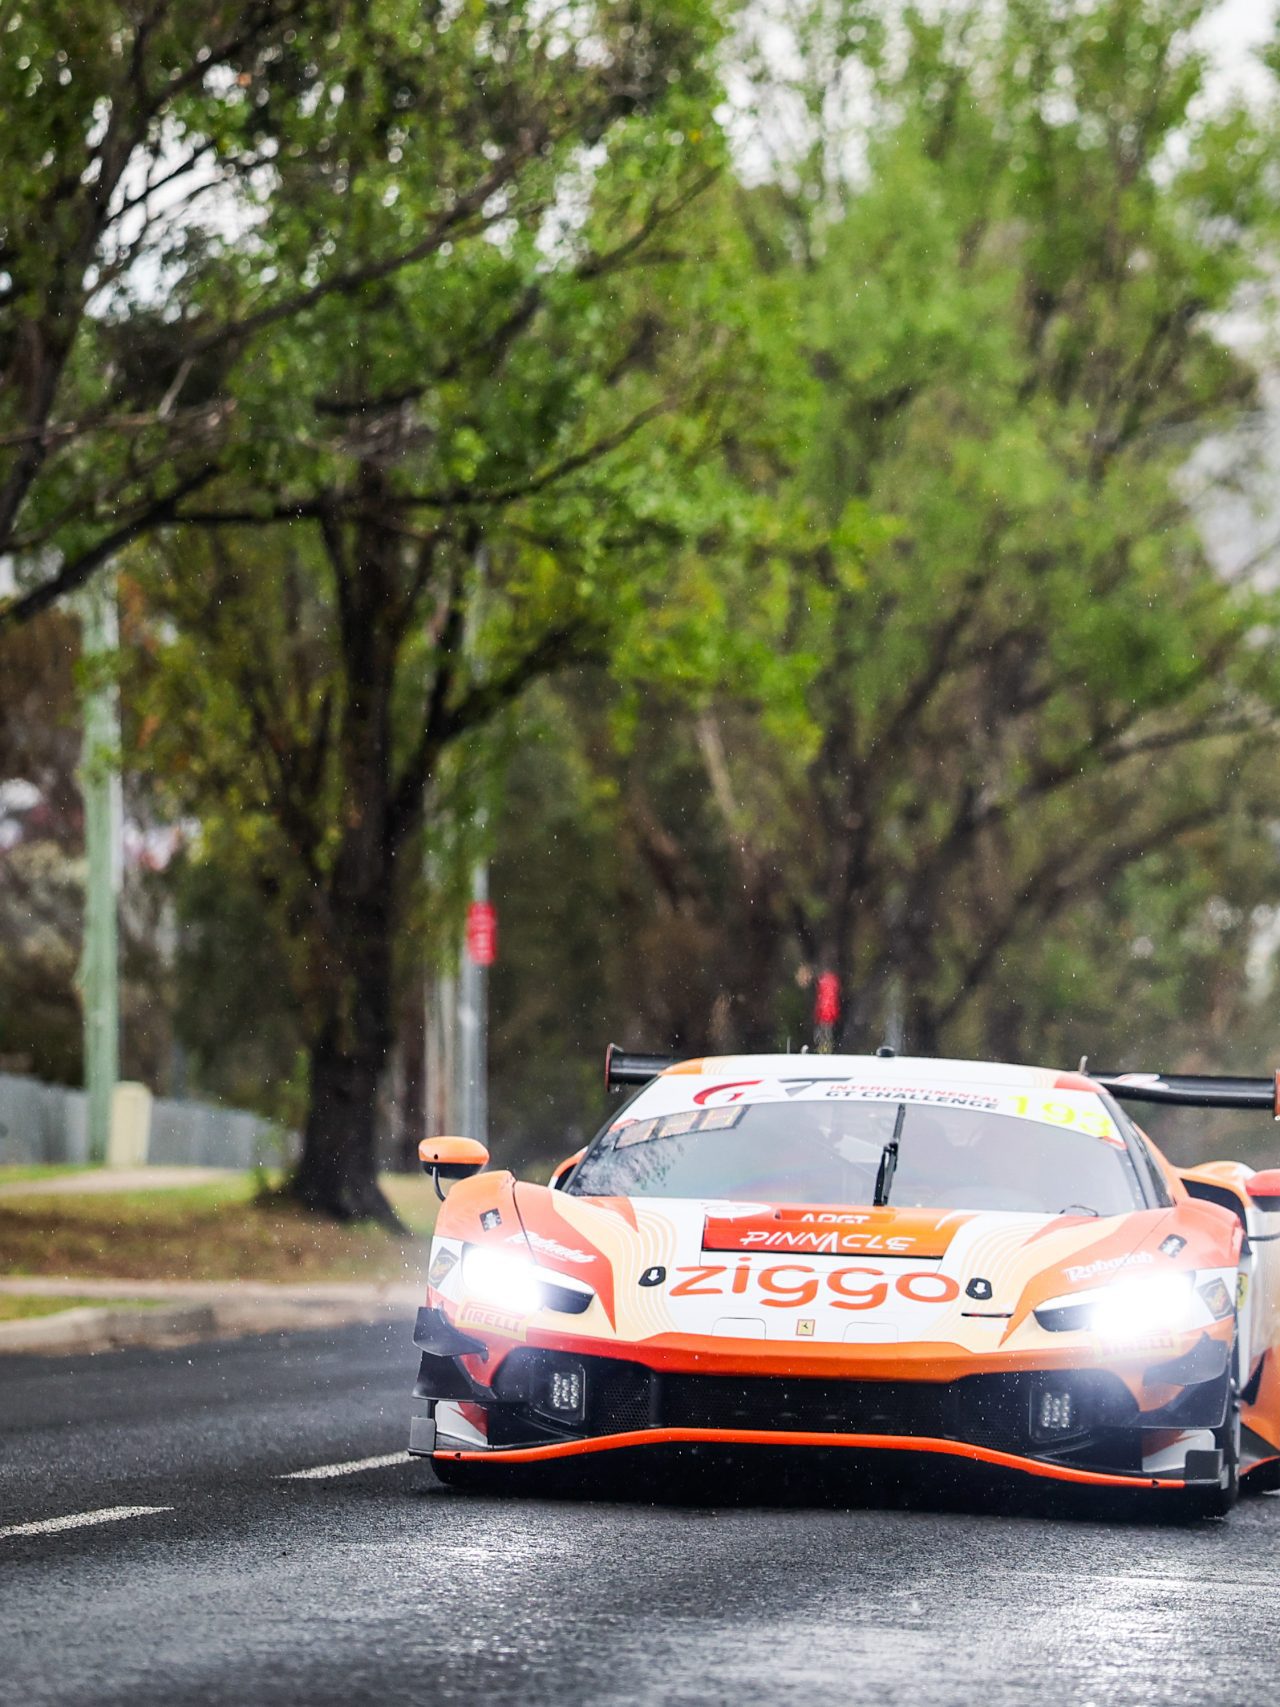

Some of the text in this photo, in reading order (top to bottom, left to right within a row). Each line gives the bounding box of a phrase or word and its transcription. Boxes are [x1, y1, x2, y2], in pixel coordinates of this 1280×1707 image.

[825, 1089, 1000, 1111] GT CHALLENGE
[1008, 1095, 1112, 1137] 193
[738, 1231, 917, 1253] PINNACLE
[668, 1256, 961, 1311] ziggo
[460, 1300, 528, 1333] PIRELLI
